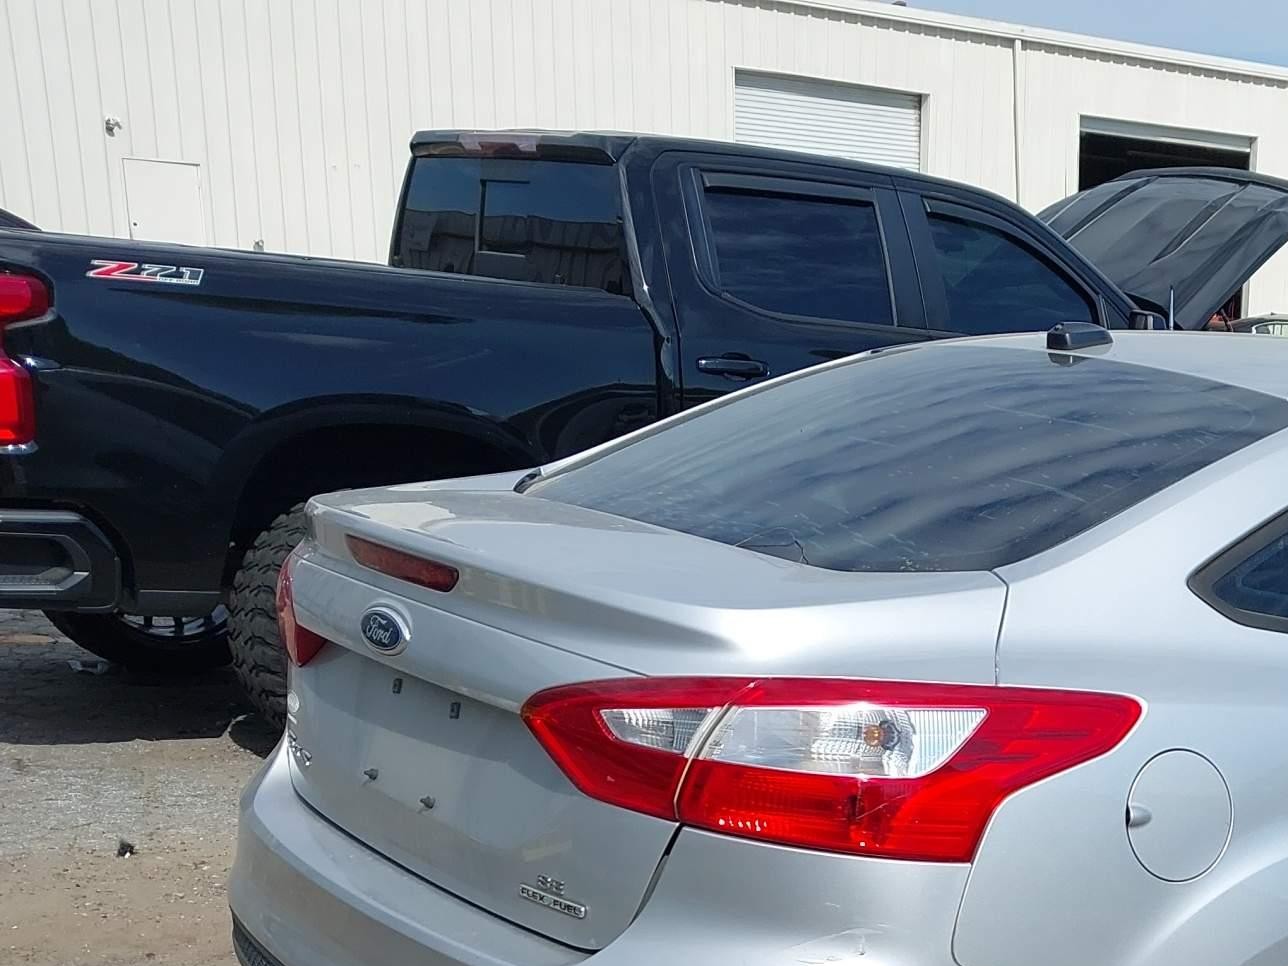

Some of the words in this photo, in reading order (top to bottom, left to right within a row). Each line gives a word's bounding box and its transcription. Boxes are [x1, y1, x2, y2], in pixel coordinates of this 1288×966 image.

[85, 259, 204, 285] Z71
[366, 614, 394, 644] Ford
[537, 873, 565, 895] SE
[521, 886, 545, 904] FLEX
[553, 899, 581, 917] FUEL
